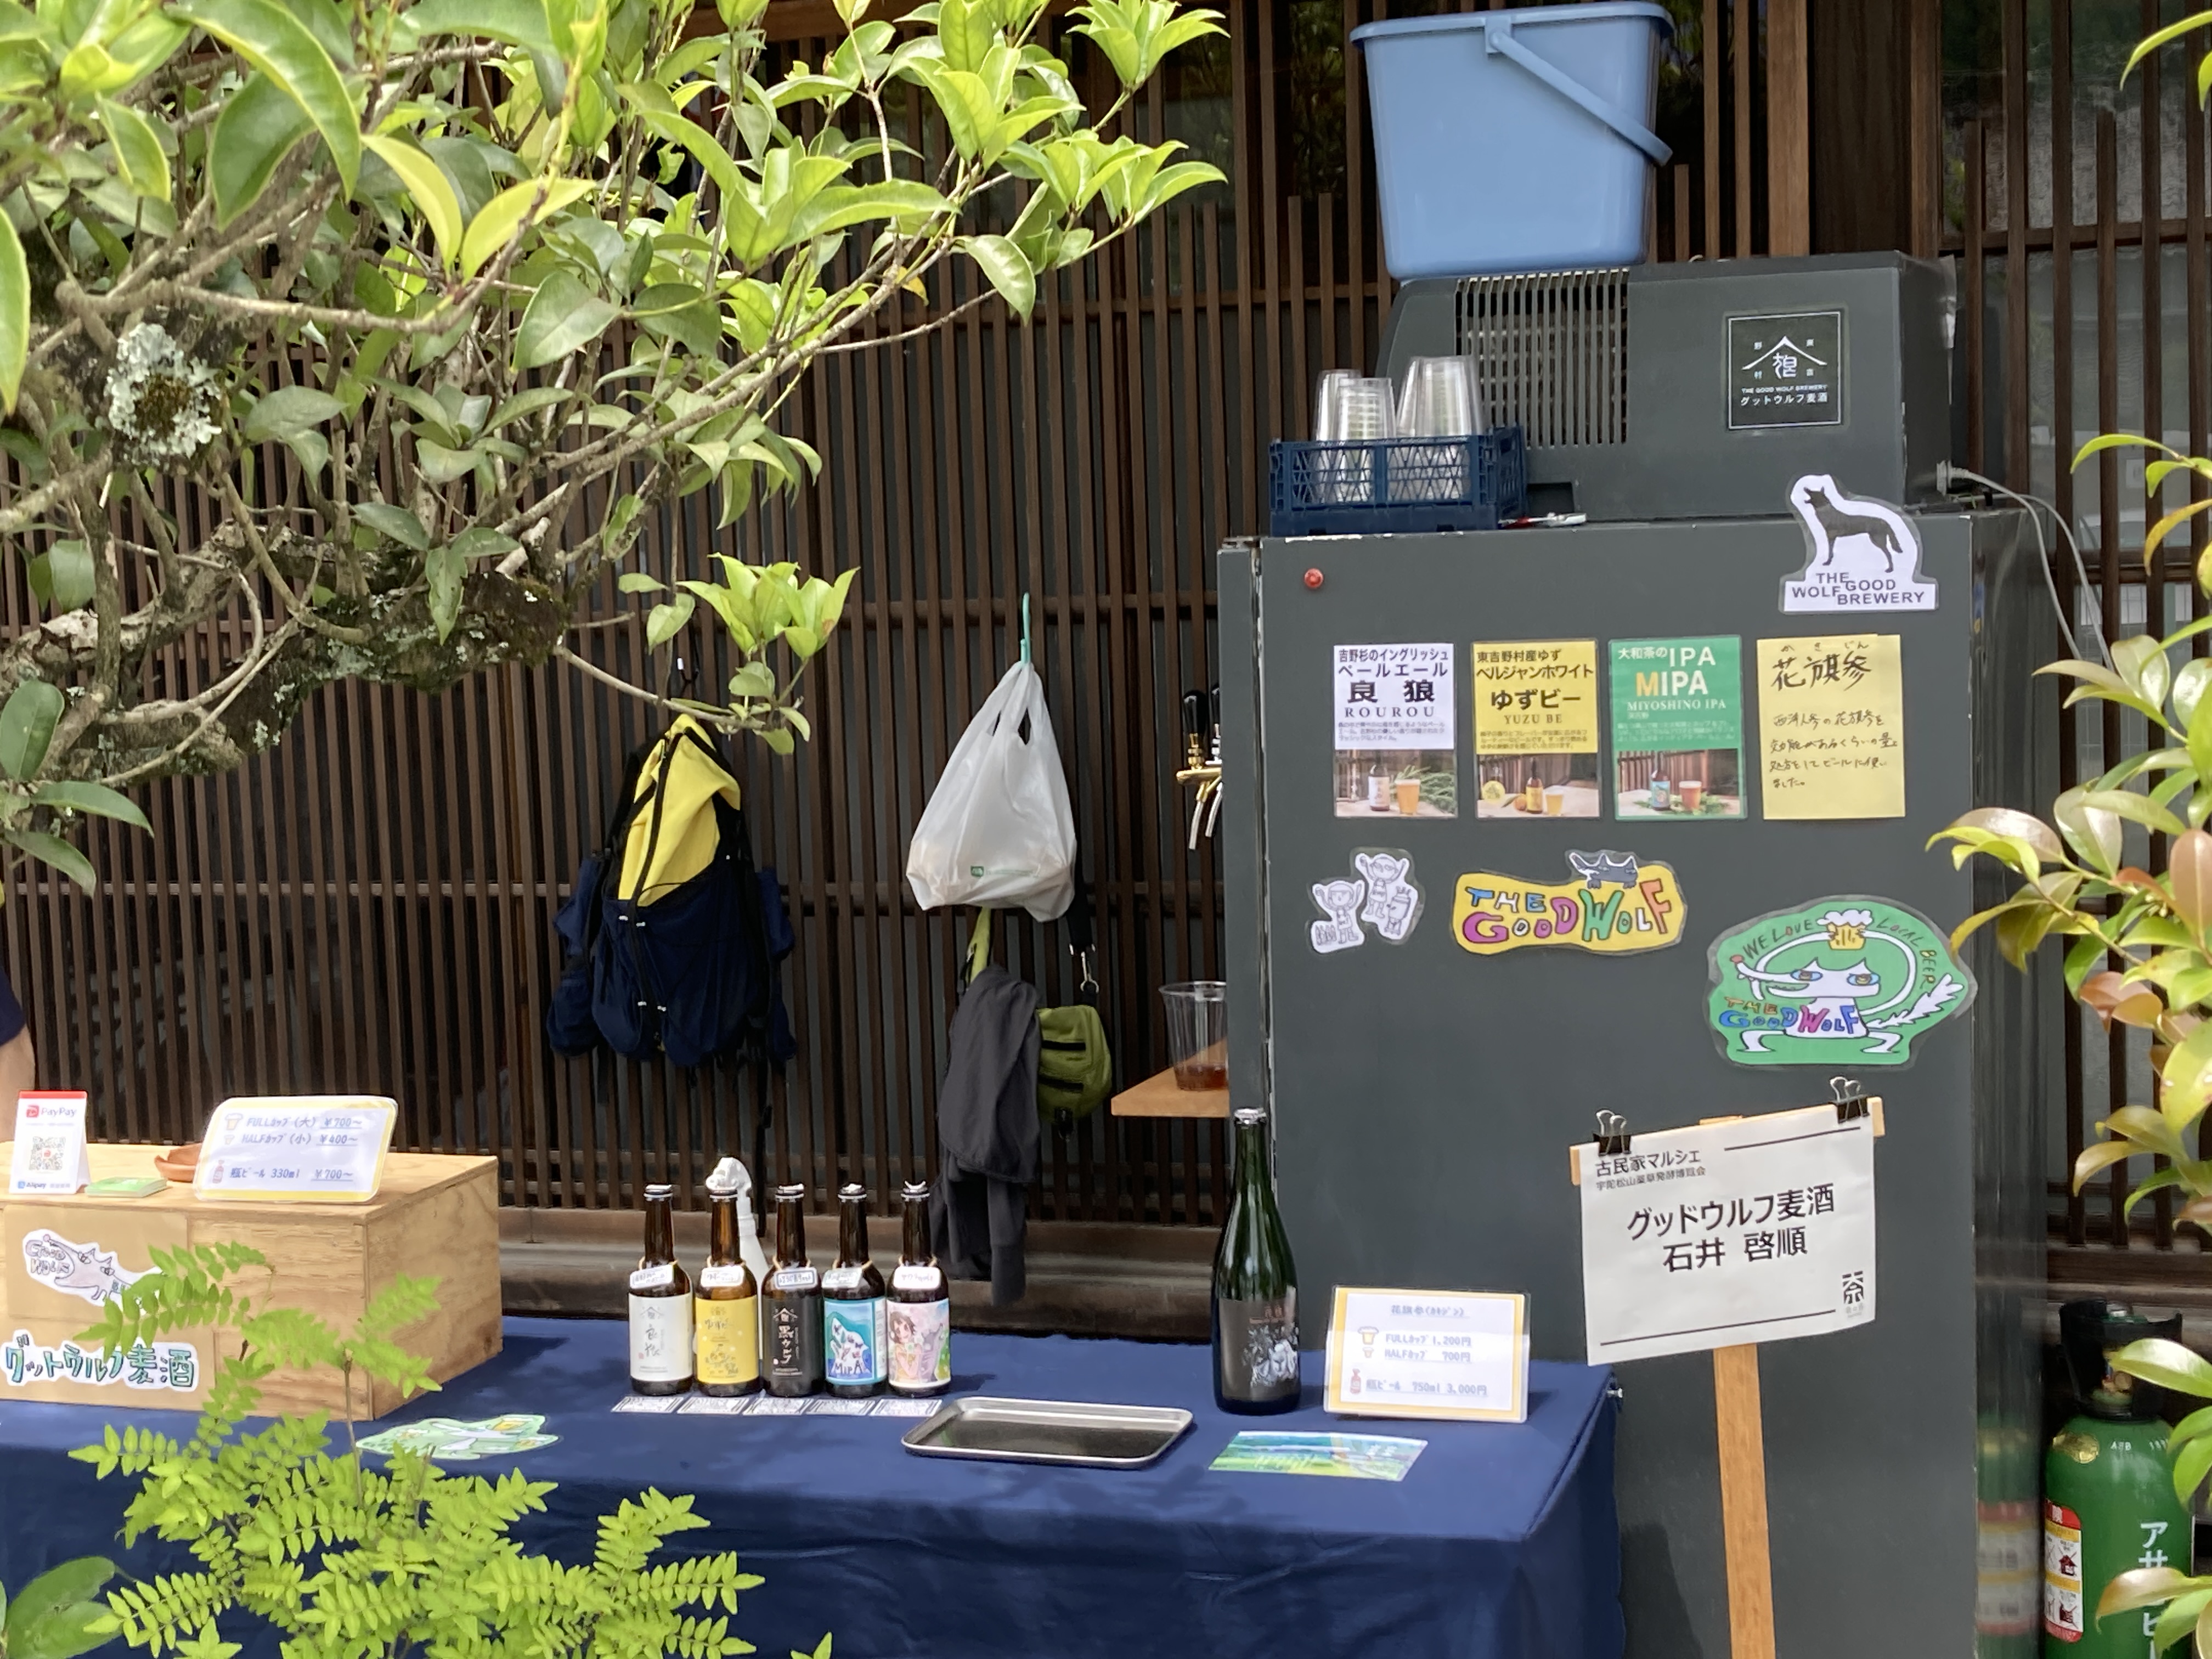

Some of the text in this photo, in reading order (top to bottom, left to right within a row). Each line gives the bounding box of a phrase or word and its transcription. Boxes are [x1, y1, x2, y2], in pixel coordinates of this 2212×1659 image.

[1816, 572, 1896, 591] THE GOOD
[1792, 586, 1925, 605] WOLF BREWERY
[1338, 648, 1448, 663] 吉野杉のイングリッシュ
[1477, 649, 1562, 663] 東吉野村産ゆず
[1338, 662, 1448, 678] ペールエール
[1476, 664, 1594, 680] ベルジャンホワイト
[1771, 651, 1872, 691] 花旗参
[1635, 670, 1708, 697] MIPA
[1491, 689, 1581, 710] ゆずビー
[1627, 698, 1726, 711] MIYOSHINO IPA
[1345, 707, 1435, 718] ROUROU
[1504, 714, 1562, 725] YUZU BE
[1465, 887, 1546, 913] THE
[1463, 878, 1672, 944] GOOD WOLF
[1743, 934, 1767, 960] WE
[1773, 921, 1812, 942] LOVE
[1877, 917, 1924, 947] LOCAL
[1724, 996, 1778, 1015] THE
[1719, 1005, 1859, 1034] GOOD WOLF
[41, 1107, 77, 1118] PayPay
[1596, 1149, 1701, 1177] 古民家マルシェ
[1627, 1183, 1835, 1240] グッドウルフ麦酒
[1662, 1226, 1807, 1272] 石井 啓順
[1442, 1351, 1471, 1362] 700円
